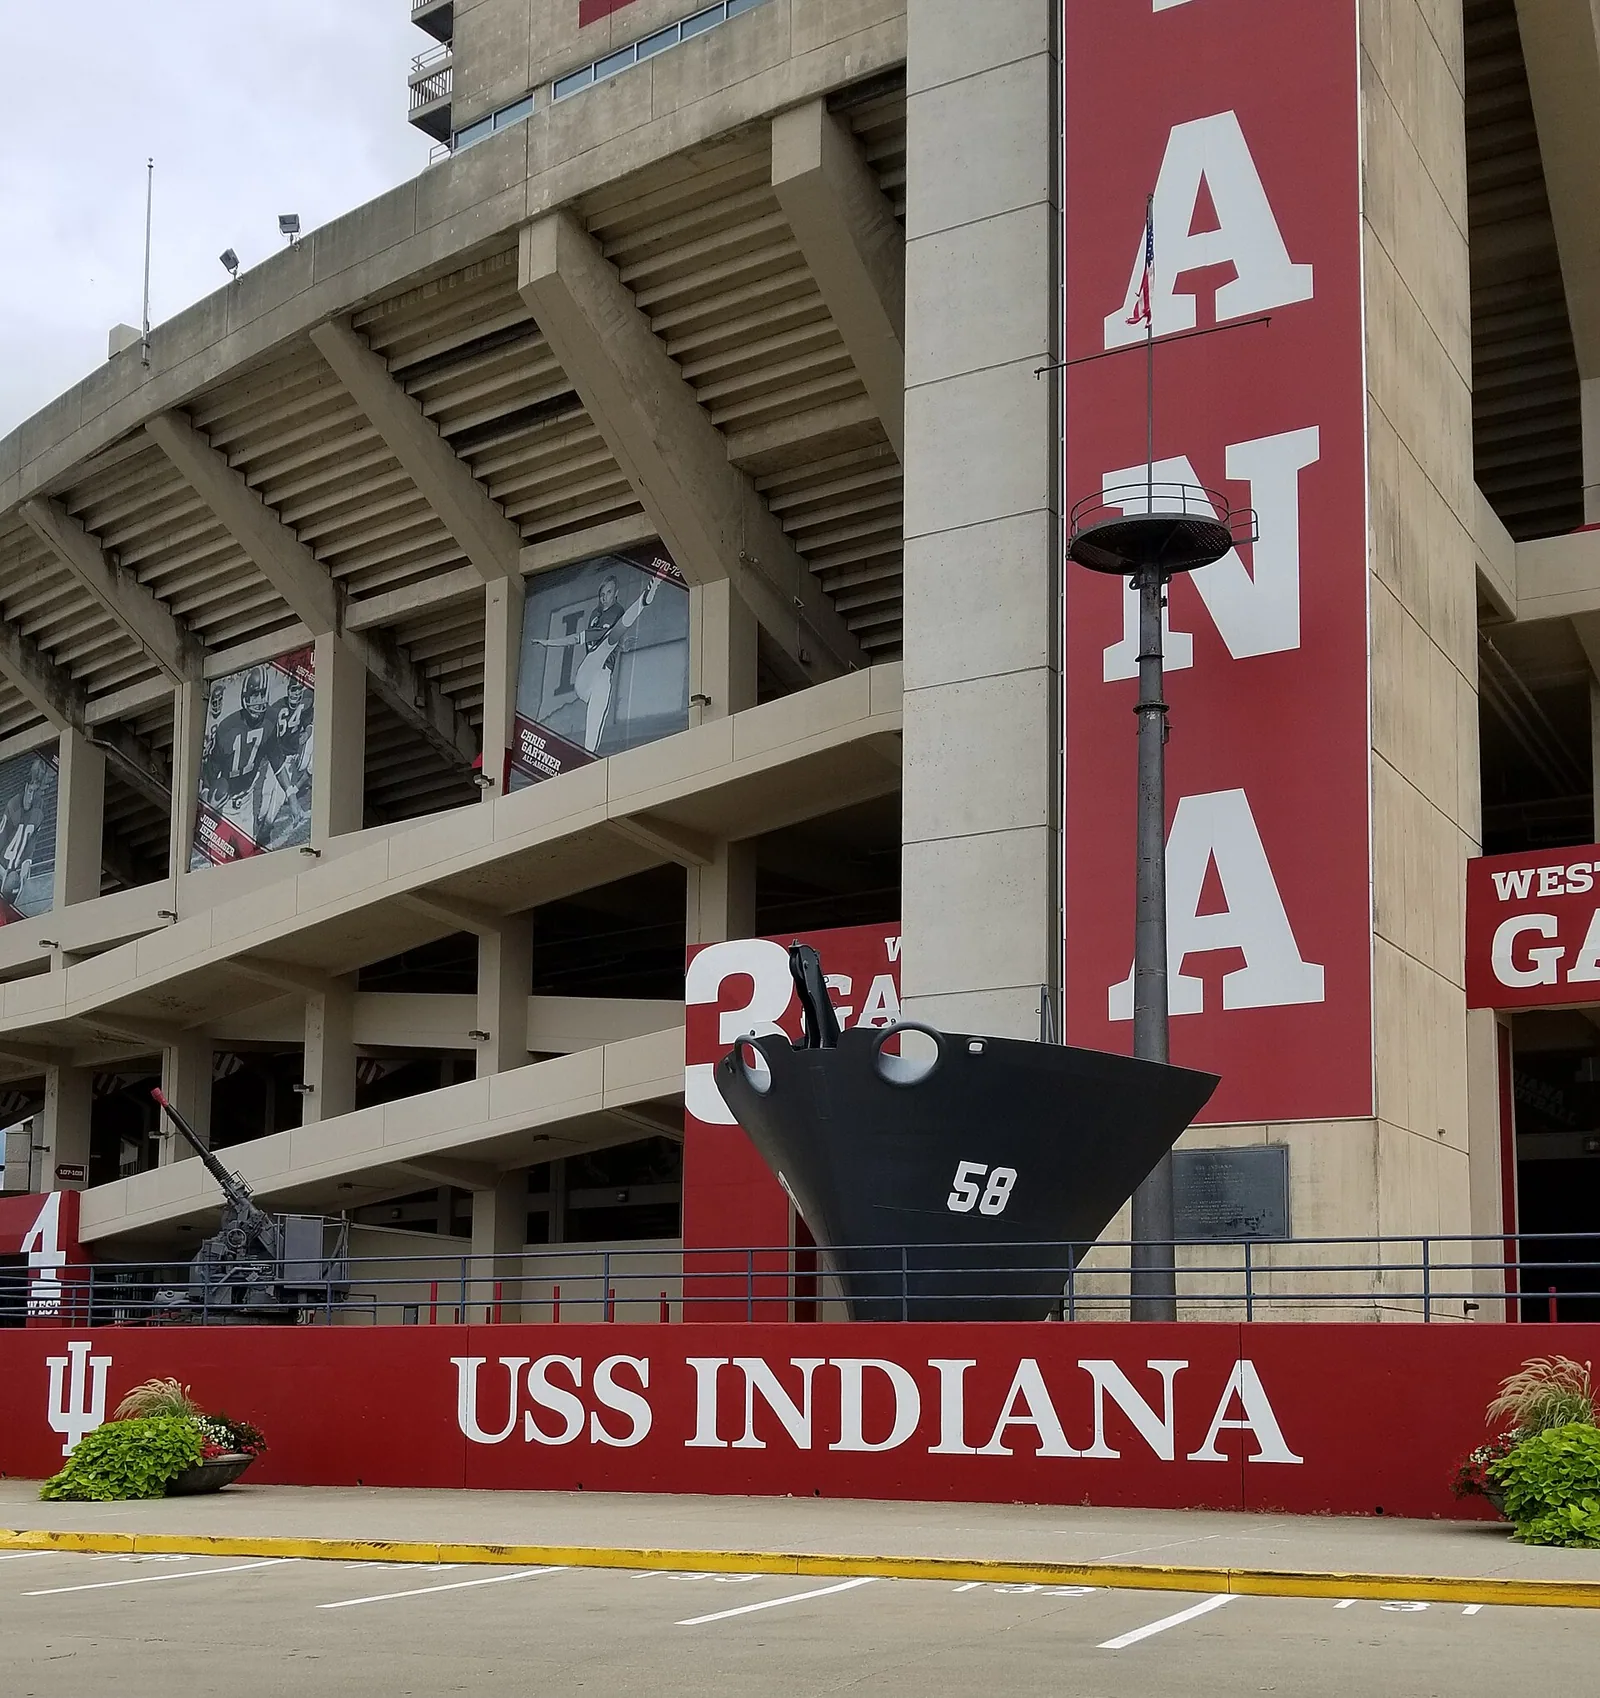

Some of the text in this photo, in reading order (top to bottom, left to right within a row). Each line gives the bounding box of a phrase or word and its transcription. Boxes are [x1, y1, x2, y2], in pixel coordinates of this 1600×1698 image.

[1103, 0, 1325, 1021] ANA
[651, 557, 681, 577] 1970-72
[229, 727, 264, 778] 17
[520, 728, 547, 750] CHRIS
[521, 741, 562, 771] GARTNER
[1491, 862, 1600, 901] WES
[685, 939, 795, 1125] 3
[947, 1160, 1018, 1216] 58
[20, 1191, 66, 1298] 4
[27, 1300, 61, 1315] WEST
[450, 1354, 1304, 1463] USS INDIANA
